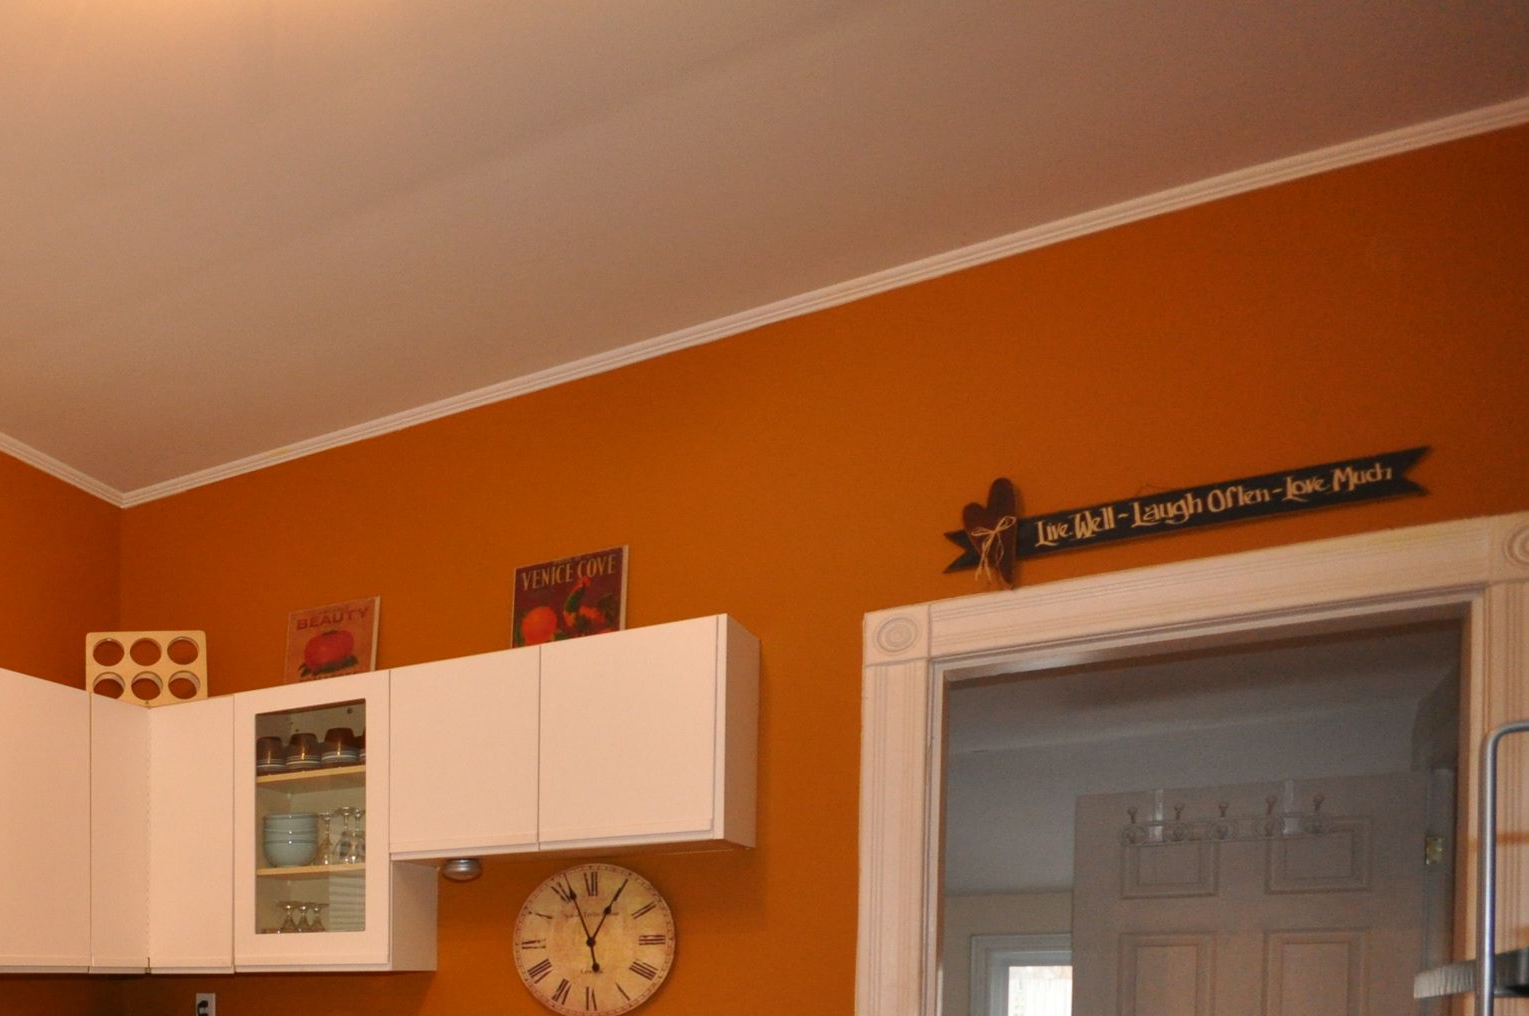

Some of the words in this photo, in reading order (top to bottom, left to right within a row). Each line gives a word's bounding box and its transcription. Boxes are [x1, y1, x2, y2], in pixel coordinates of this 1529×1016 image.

[1035, 519, 1072, 547] Live
[1073, 505, 1115, 540] Well
[1131, 493, 1203, 528] Laugh
[1207, 485, 1271, 513] Often
[1282, 476, 1330, 503] Love
[1332, 463, 1393, 493] Much
[521, 563, 575, 591] VENICE
[577, 554, 616, 578] COVE
[296, 605, 370, 631] BEAUTY
